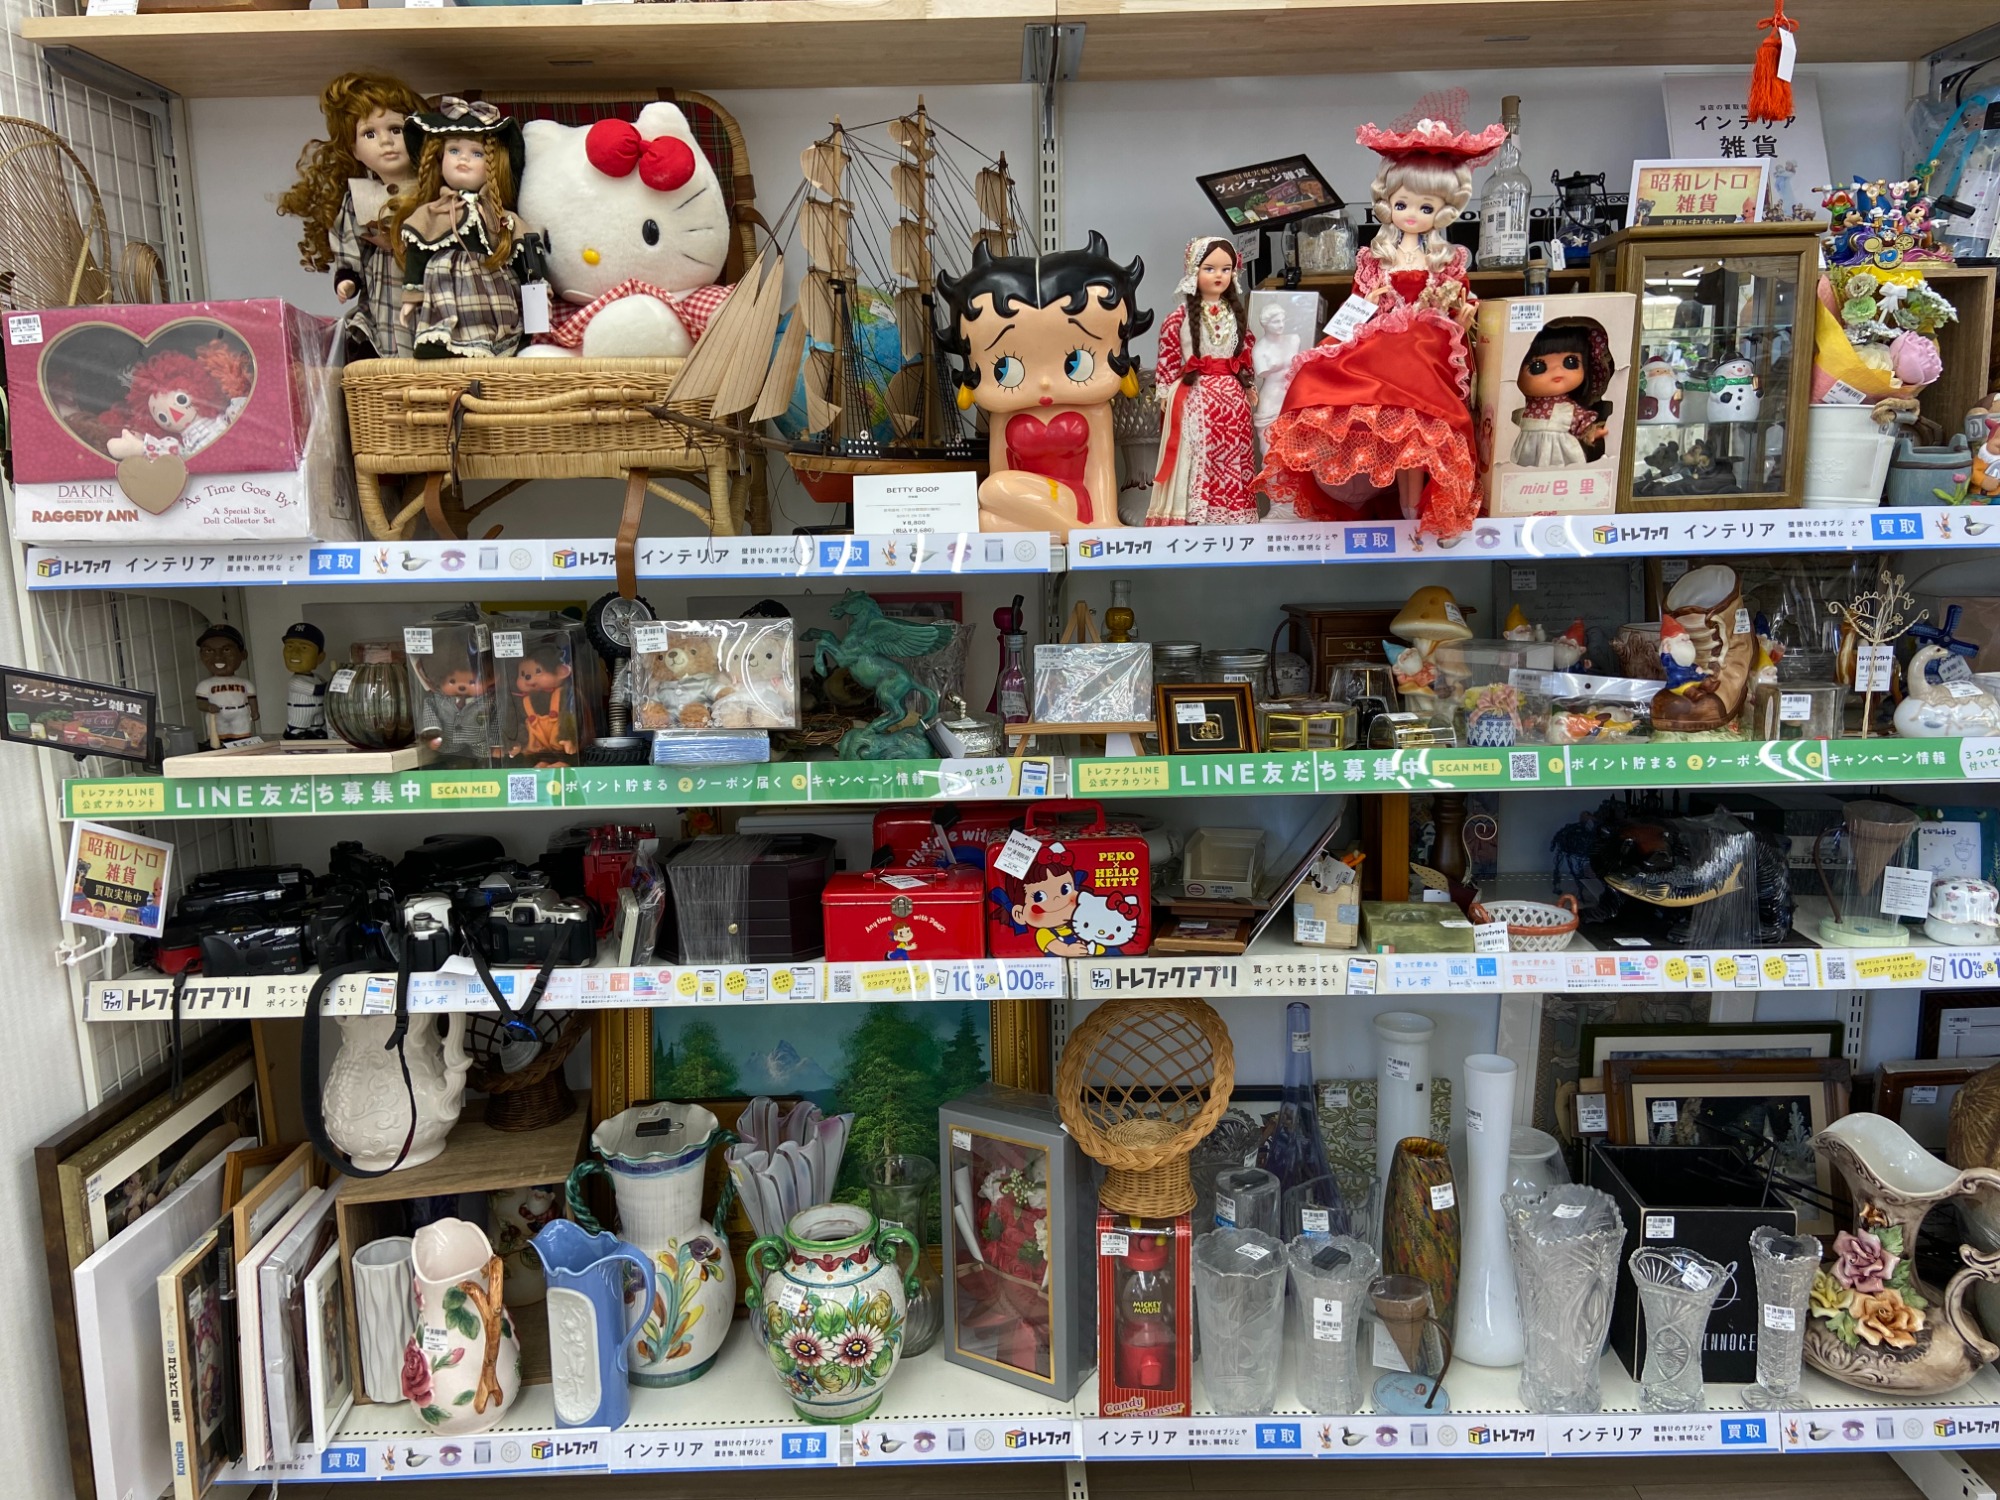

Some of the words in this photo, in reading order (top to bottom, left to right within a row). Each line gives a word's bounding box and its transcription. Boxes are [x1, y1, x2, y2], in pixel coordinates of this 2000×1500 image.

[1699, 104, 1748, 112] 当店の買取強
[1694, 115, 1796, 131] インテリア
[1720, 135, 1779, 158] 雑貨
[1215, 168, 1309, 194] ヴィンテージ雑貨
[1650, 173, 1749, 192] 昭和レトロ
[1676, 193, 1719, 215] 雑貨
[58, 484, 114, 498] DAKIN
[203, 483, 236, 497] Time
[241, 481, 271, 497] Goes
[886, 486, 914, 494] BETTY
[1519, 482, 1550, 495] mini
[32, 509, 103, 523] RAGGEDY
[106, 509, 139, 523] ANN
[223, 507, 250, 516] Special
[254, 507, 266, 515] Six
[203, 516, 220, 525] Doll
[223, 516, 260, 525] Collector
[264, 516, 276, 525] Set
[1878, 518, 1916, 535] 買取
[1621, 526, 1668, 541] トレファク
[1684, 522, 1775, 538] インテリア
[1106, 540, 1153, 554] トレファク
[1166, 536, 1255, 553] インテリア
[1352, 532, 1390, 550] 買取
[317, 553, 354, 569] 買取
[580, 552, 616, 566] トレファ
[641, 547, 730, 565] インテリア
[827, 546, 863, 561] 買取
[64, 559, 111, 575] トレファク
[126, 556, 215, 573] インテリア
[741, 557, 796, 566] 置き物、照明な
[210, 684, 246, 695] GIANTS
[12, 683, 142, 715] ヴィンテージ雑貨
[1438, 762, 1472, 772] SCAN
[1571, 757, 1677, 771] ポイント貯まる
[1829, 751, 1946, 767] キャンペーン情報
[954, 763, 1005, 776] つのお得が
[1086, 766, 1160, 776] トレファクLINE
[1180, 757, 1421, 787] LINE友だち募集中
[437, 785, 469, 795] SCAN
[565, 779, 667, 794] ポイント貯まる
[696, 776, 783, 791] クーポン届く
[811, 771, 925, 788] キャンペーン情報
[1088, 777, 1160, 788] 公式アカウント
[80, 788, 155, 797] トレファクLINE
[176, 780, 421, 808] LINE友だち募集中
[82, 798, 155, 809] 公式アカウント
[963, 829, 987, 843] wit
[88, 836, 159, 868] 昭和レトロ
[1098, 851, 1136, 862] PEKO
[105, 862, 137, 886] 雑貨
[1095, 867, 1139, 878] HELLO
[1095, 876, 1139, 888] KITTY
[95, 884, 142, 904] 買取実施中
[912, 914, 928, 922] with
[1092, 970, 1105, 979] トレ
[1253, 964, 1339, 974] 買っても売っても
[1949, 958, 1973, 979] 10
[1973, 961, 1982, 970] %
[1974, 971, 1988, 979] UP
[1987, 963, 1994, 972] &
[867, 975, 927, 987] 2つのアプリクポン
[976, 973, 985, 982] %
[1035, 972, 1043, 981] 円
[1116, 965, 1237, 990] トレファクアプリ
[1254, 977, 1336, 987] ポイント貯まる!
[1513, 974, 1537, 985] 買取
[267, 984, 357, 995] 買ってもっても
[976, 983, 989, 991] UP
[1036, 981, 1055, 990] OFF
[104, 991, 116, 1000] トレ
[127, 986, 251, 1010] トレフクアプリ
[266, 997, 353, 1008] ポイントまる!
[1133, 1301, 1162, 1309] MICKEY
[1133, 1306, 1161, 1314] MOUSE
[1325, 1303, 1332, 1312] 6
[1703, 1333, 1757, 1351] INNOCE
[1104, 1397, 1143, 1414] Candy
[1493, 1427, 1535, 1442] トレファク
[1727, 1423, 1761, 1439] 買取
[1958, 1419, 2000, 1435] トレファク
[1029, 1431, 1071, 1446] トレファク
[1098, 1430, 1177, 1446] インテリア
[1262, 1429, 1296, 1444] 買取
[1562, 1427, 1643, 1443] インテリア
[556, 1440, 598, 1456] トレファク
[623, 1441, 704, 1458] インテリア
[788, 1437, 820, 1454] 買取
[175, 1441, 186, 1475] Konica
[327, 1451, 361, 1468] 買取
